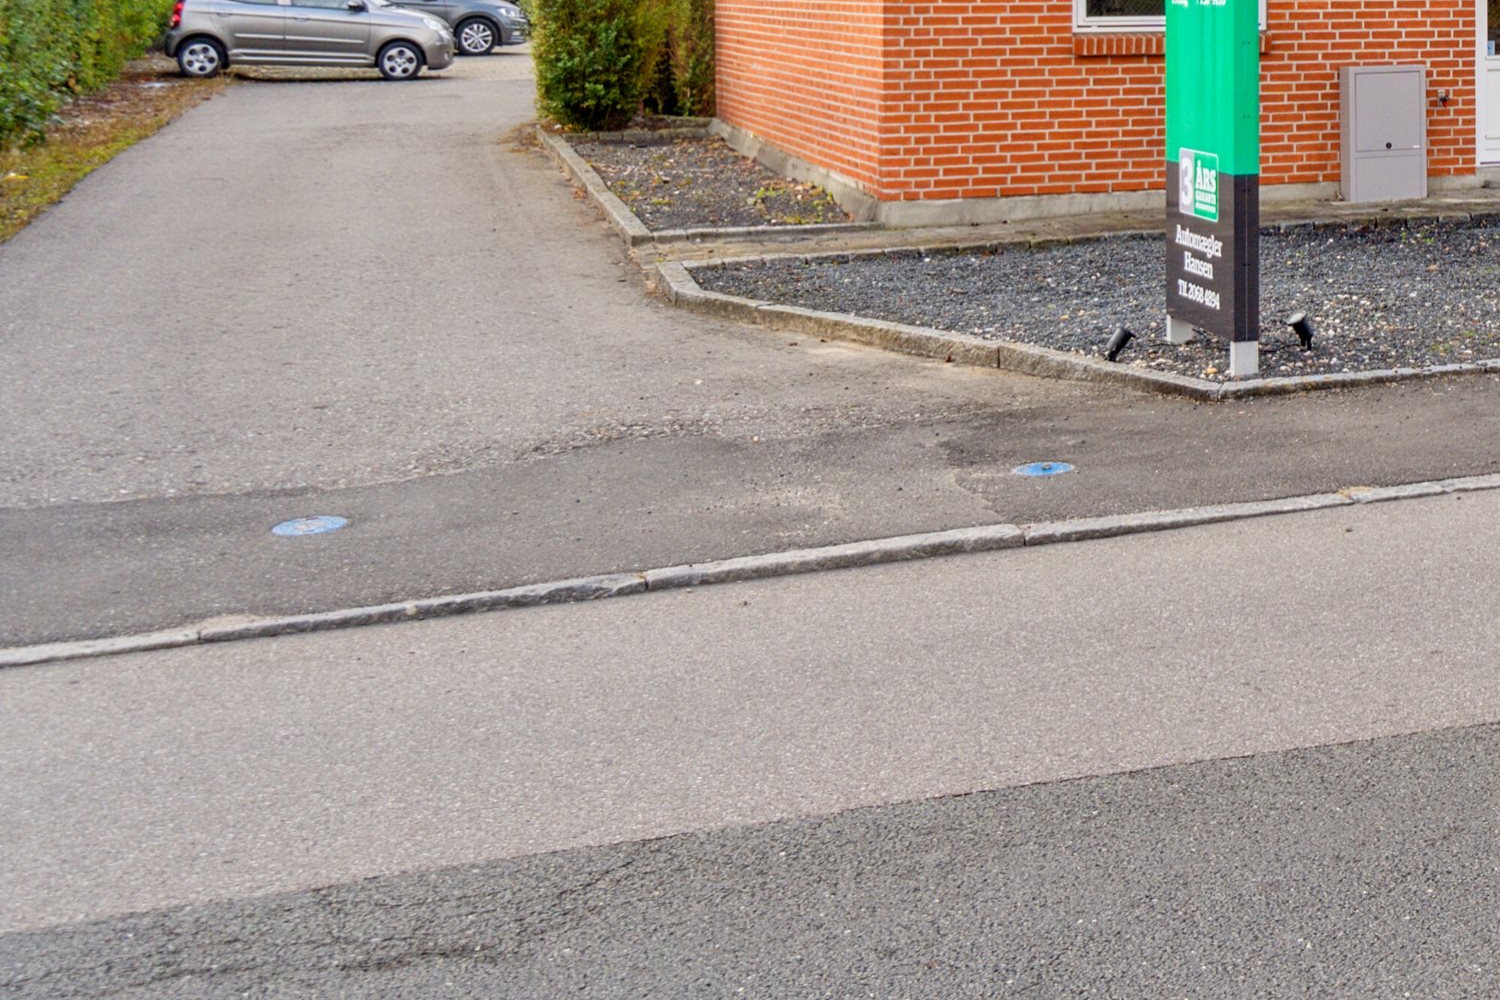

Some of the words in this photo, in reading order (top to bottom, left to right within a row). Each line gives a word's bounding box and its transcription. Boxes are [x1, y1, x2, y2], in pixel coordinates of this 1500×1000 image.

[1181, 157, 1194, 206] 3
[1195, 159, 1217, 193] ÅRS
[1184, 251, 1213, 279] Hansen
